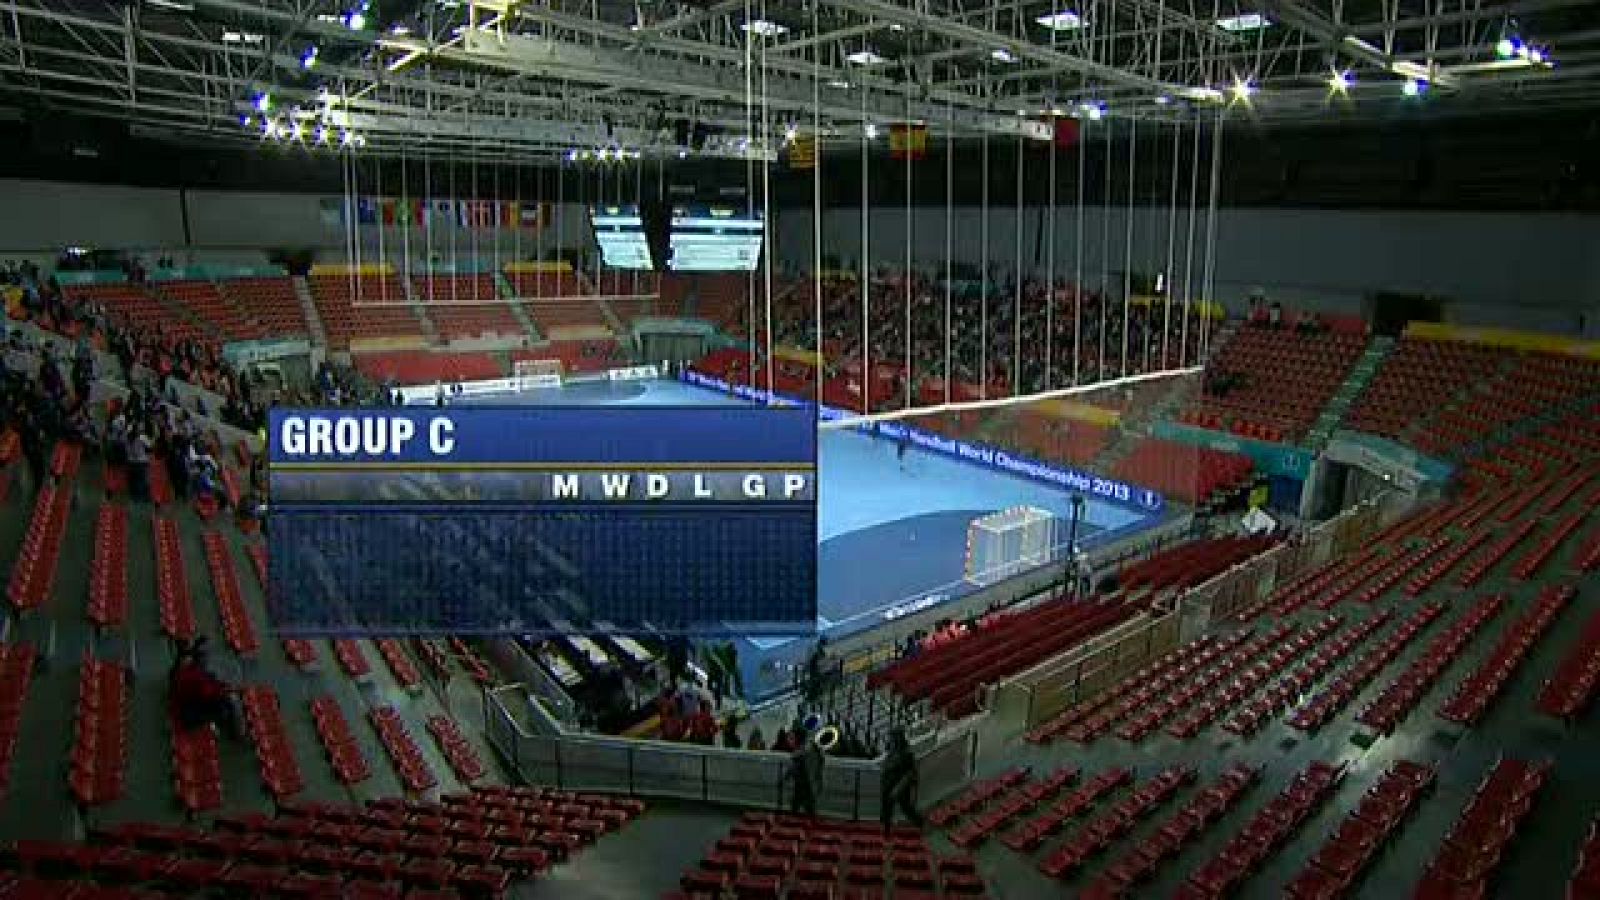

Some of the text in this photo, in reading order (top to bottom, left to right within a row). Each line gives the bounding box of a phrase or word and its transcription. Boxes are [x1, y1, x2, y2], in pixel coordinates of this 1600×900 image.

[959, 442, 994, 464] World
[994, 450, 1091, 491] Championship
[1092, 477, 1130, 501] 2013
